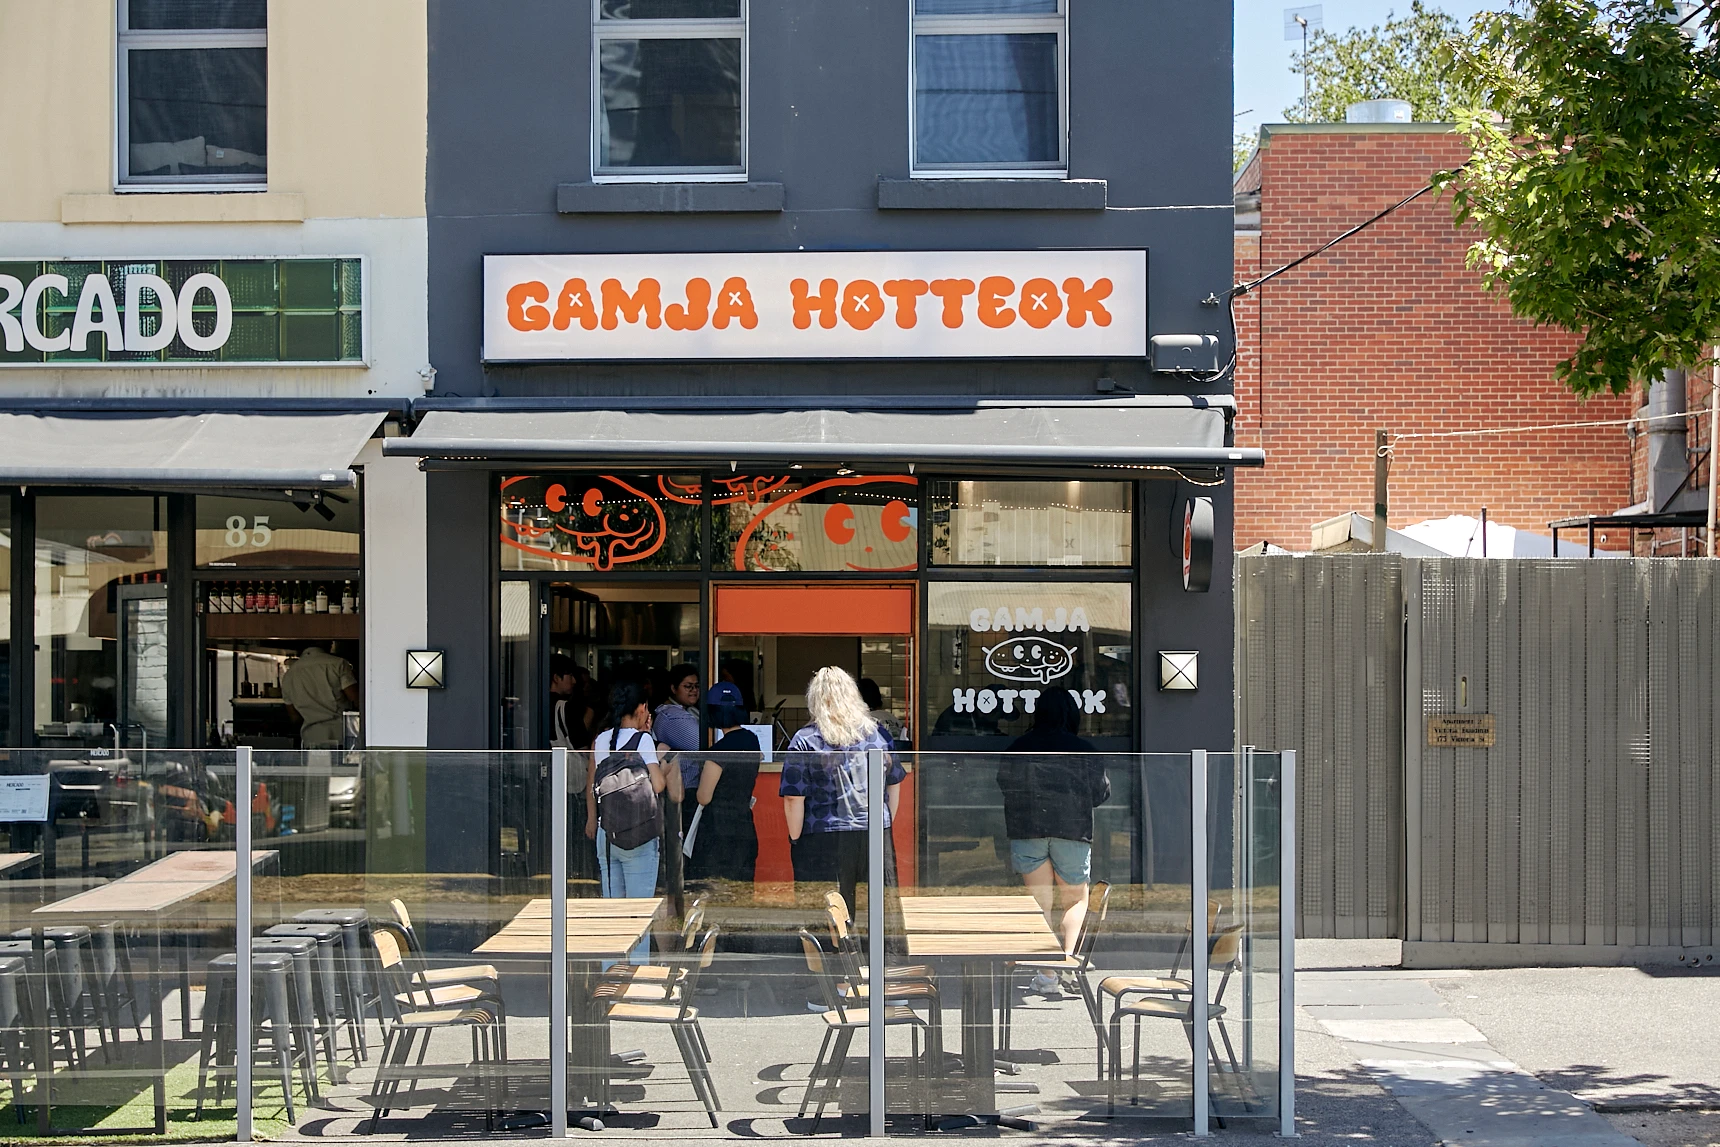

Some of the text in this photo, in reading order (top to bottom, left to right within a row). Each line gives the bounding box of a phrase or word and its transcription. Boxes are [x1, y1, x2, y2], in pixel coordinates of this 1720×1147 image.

[506, 276, 1113, 332] GAMJA HOTTEOK
[224, 515, 272, 548] 85
[969, 606, 1090, 633] GAMJA
[952, 687, 1107, 714] HOTTK
